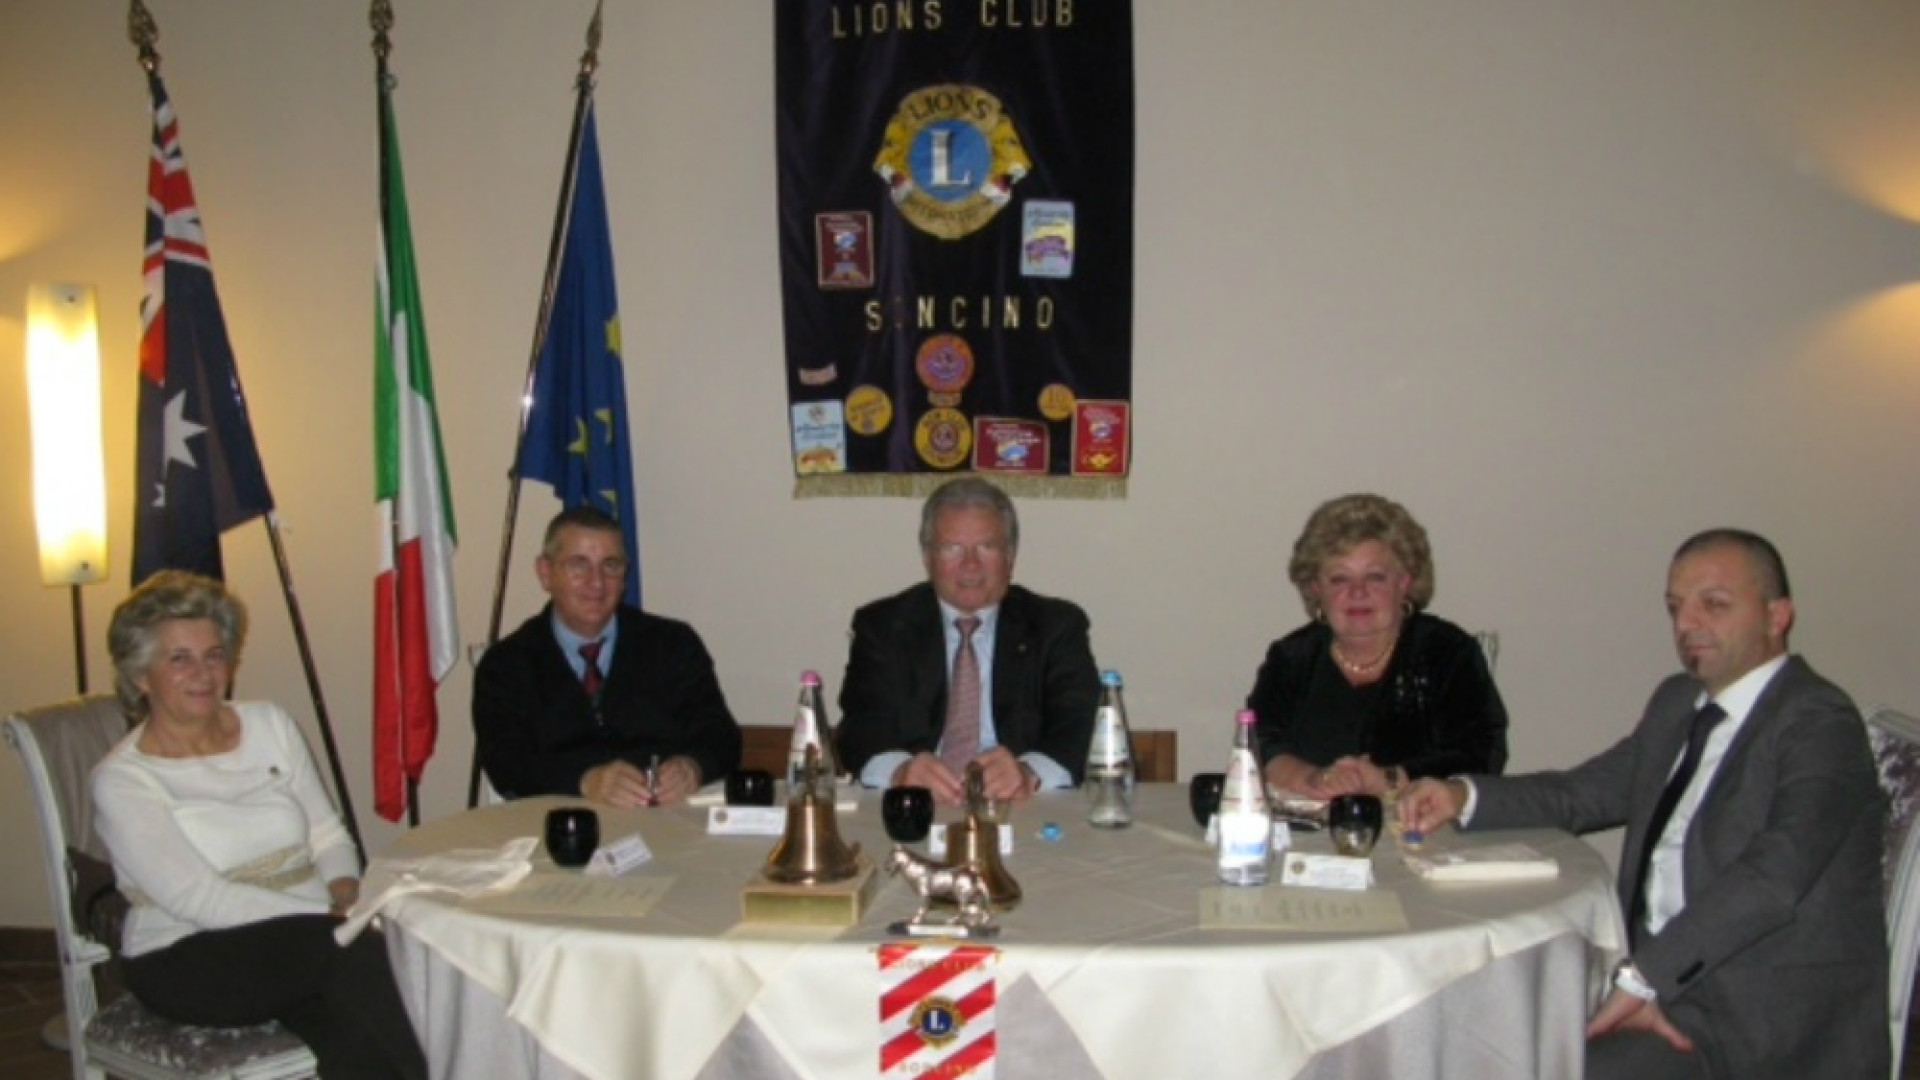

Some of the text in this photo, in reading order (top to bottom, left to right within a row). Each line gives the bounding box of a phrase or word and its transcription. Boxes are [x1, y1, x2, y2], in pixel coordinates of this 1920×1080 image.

[831, 0, 1072, 38] LIONS CLUB
[909, 91, 992, 121] LIONS
[930, 128, 972, 186] L
[930, 1010, 946, 1029] L
